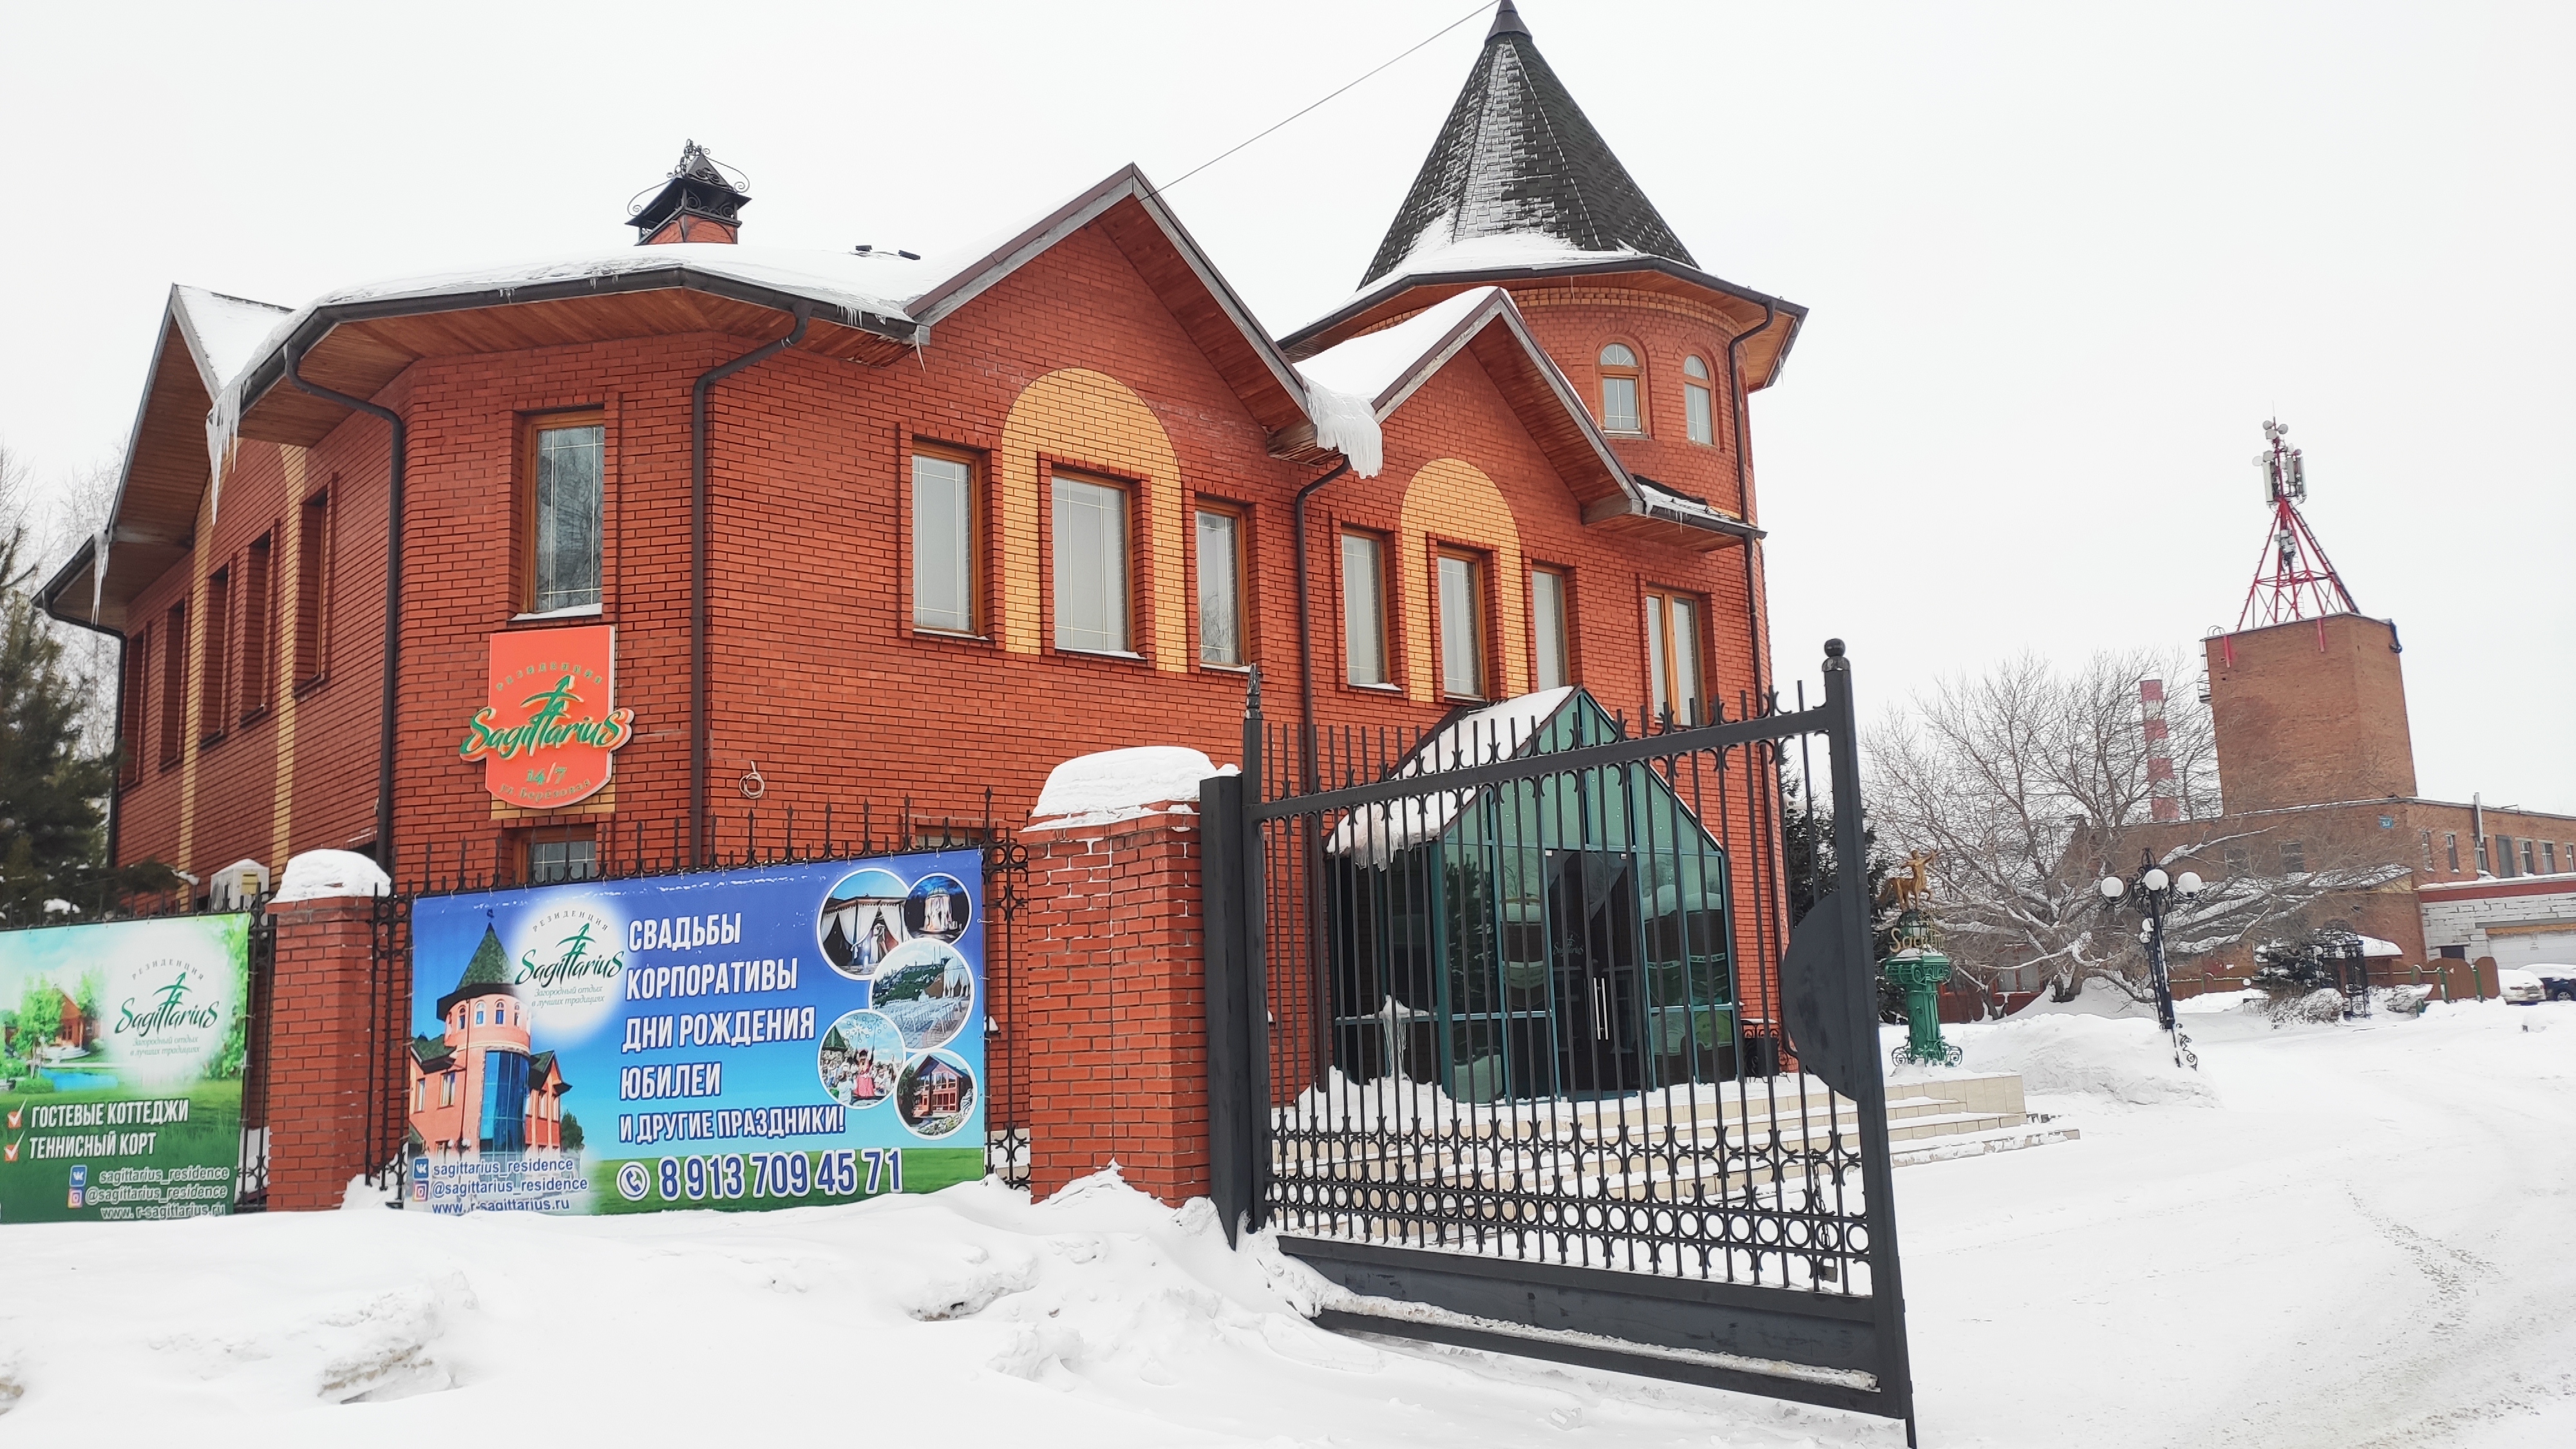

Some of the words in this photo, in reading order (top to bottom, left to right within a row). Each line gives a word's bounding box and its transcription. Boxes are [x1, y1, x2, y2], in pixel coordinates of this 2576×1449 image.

[533, 910, 609, 933] РЕЗИДЕНЦИЯ
[629, 913, 741, 952] СВАДЬБЫ
[132, 959, 204, 980] РЕЗИДЕНЦИЯ
[625, 958, 798, 1001] КОРПОРАТИВЫ
[535, 987, 576, 998] Загородный
[578, 984, 603, 994] отдых
[537, 999, 564, 1009] лучших
[565, 995, 605, 1007] традициях
[133, 1036, 173, 1047] Загородный
[174, 1034, 198, 1044] отдых
[621, 1015, 674, 1053] ДНИ
[679, 1006, 816, 1047] РОЖДЕНИЯ
[162, 1045, 200, 1056] традициях
[620, 1063, 722, 1100] ЮБИЛЕИ
[31, 1103, 104, 1128] ГОСТЕВЫЕ
[107, 1099, 189, 1125] КОТТЕДЖИ
[620, 1114, 632, 1142] И
[636, 1111, 714, 1144] ДРУГИЕ
[717, 1105, 846, 1139] ПРАЗДНИКИ!
[30, 1130, 117, 1159] ТЕННИСНЫЙ
[119, 1132, 156, 1156] КОРТ
[99, 1165, 230, 1186] sagittarius_residence
[433, 1158, 573, 1178] sagittarius_residence
[659, 1158, 679, 1199] 8
[686, 1155, 744, 1198] 913
[751, 1153, 809, 1196] 709
[816, 1151, 855, 1193] 45
[862, 1149, 901, 1191] 71
[85, 1183, 228, 1206] @sagittarius_residence
[433, 1178, 588, 1198] @sagittarius_residence
